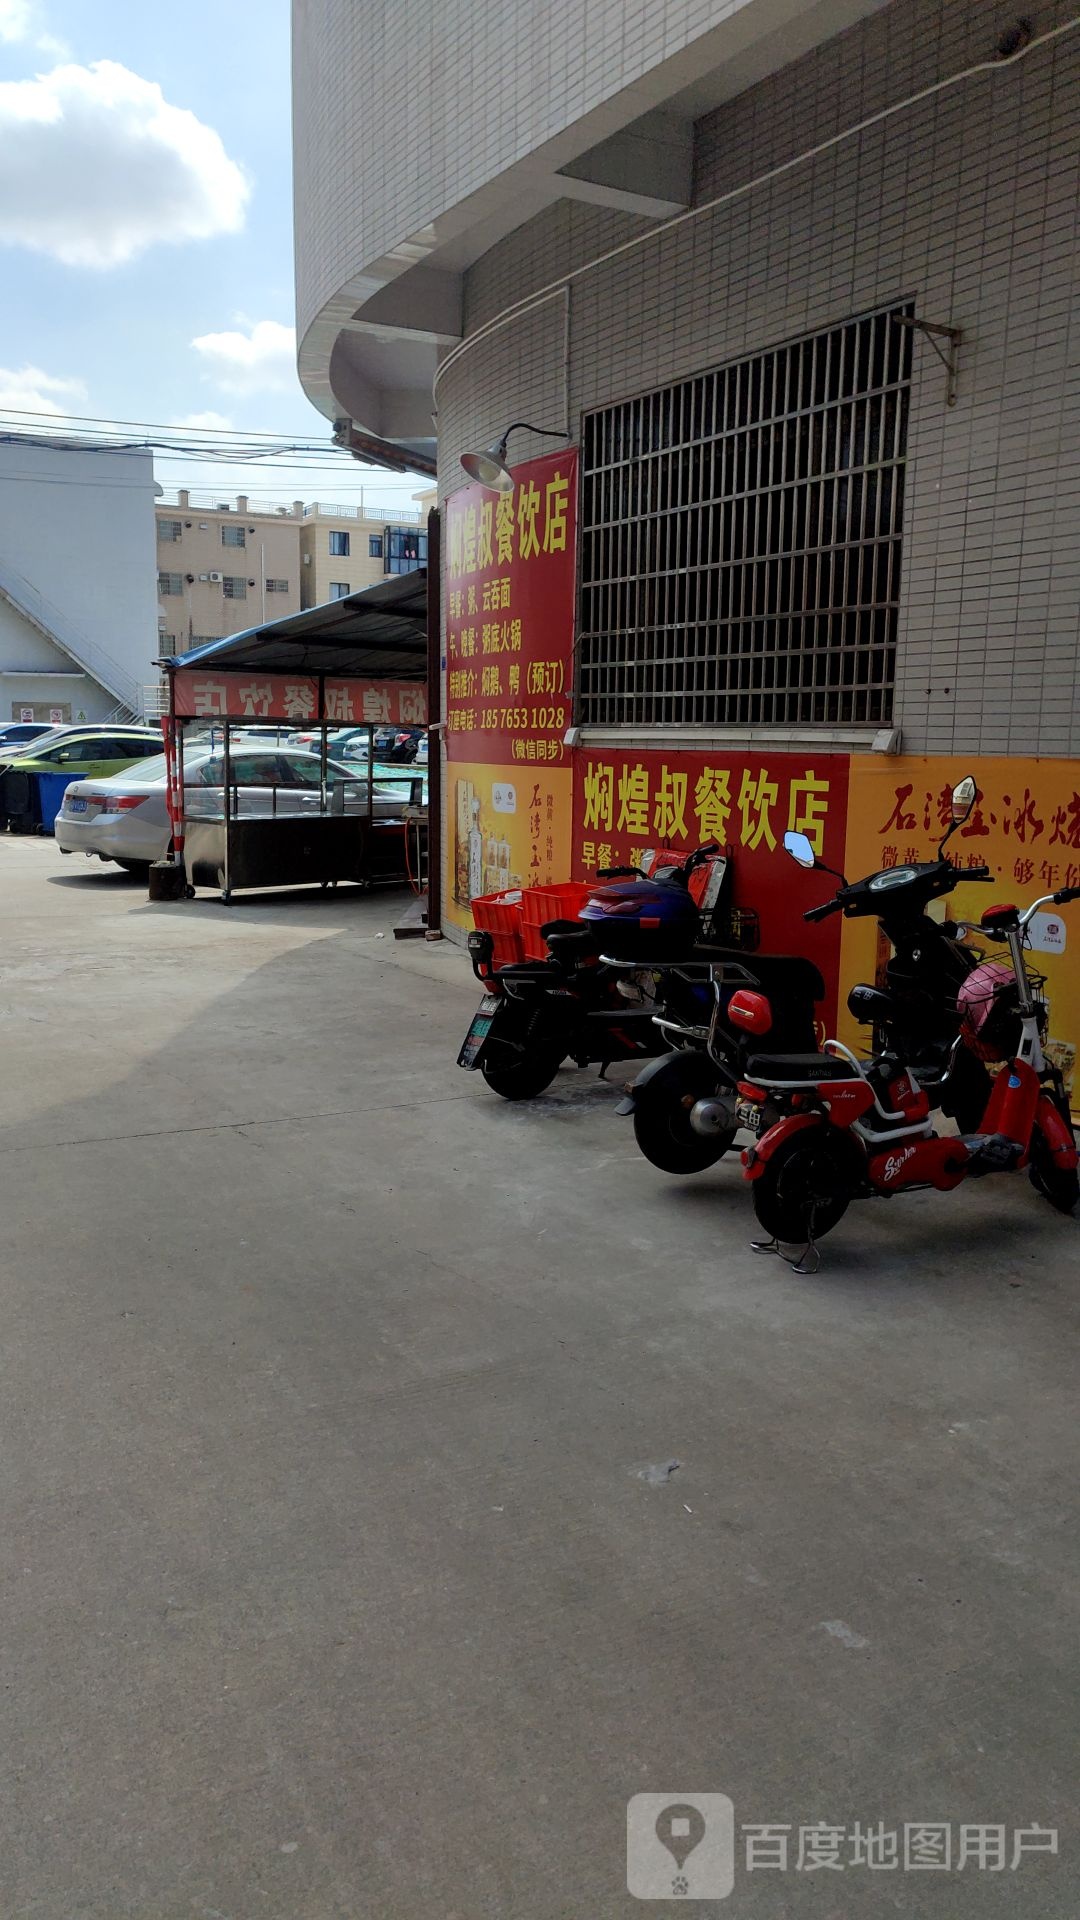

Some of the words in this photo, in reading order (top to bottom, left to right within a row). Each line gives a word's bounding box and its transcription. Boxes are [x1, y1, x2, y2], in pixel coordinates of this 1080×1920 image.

[582, 761, 830, 857] 焖煌叔餐饮店
